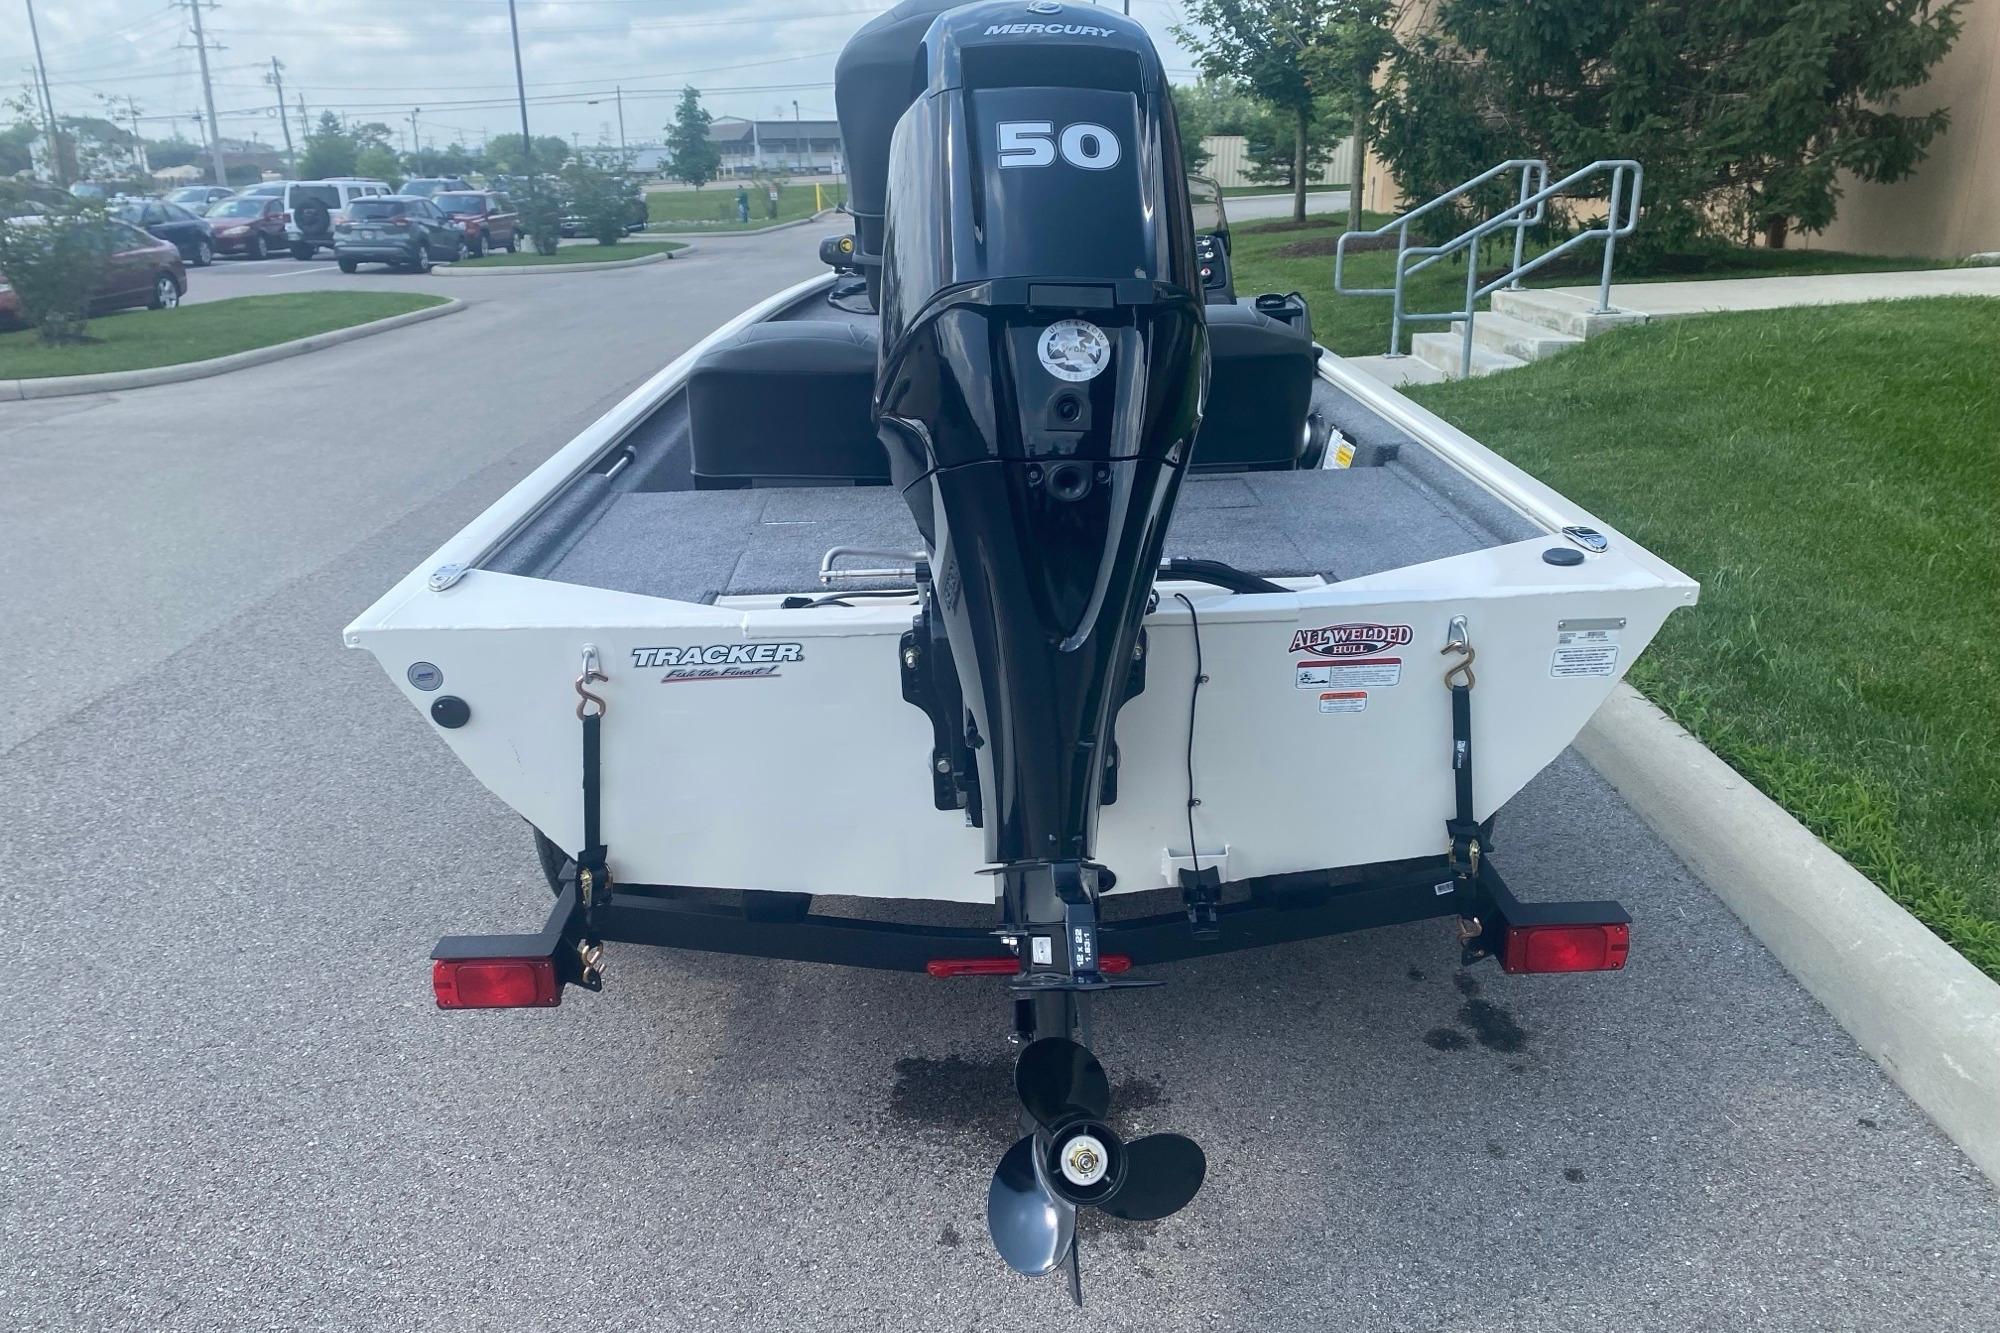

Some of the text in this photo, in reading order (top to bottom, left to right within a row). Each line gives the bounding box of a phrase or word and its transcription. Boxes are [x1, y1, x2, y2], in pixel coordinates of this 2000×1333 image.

[984, 23, 1117, 38] MERCURY
[996, 120, 1122, 171] 50
[1086, 323, 1105, 341] LOW
[1289, 625, 1413, 652] ALL WELDED
[632, 643, 804, 668] TRACKER
[1333, 644, 1368, 654] HULL
[666, 668, 696, 680] Fish
[698, 667, 719, 678] the
